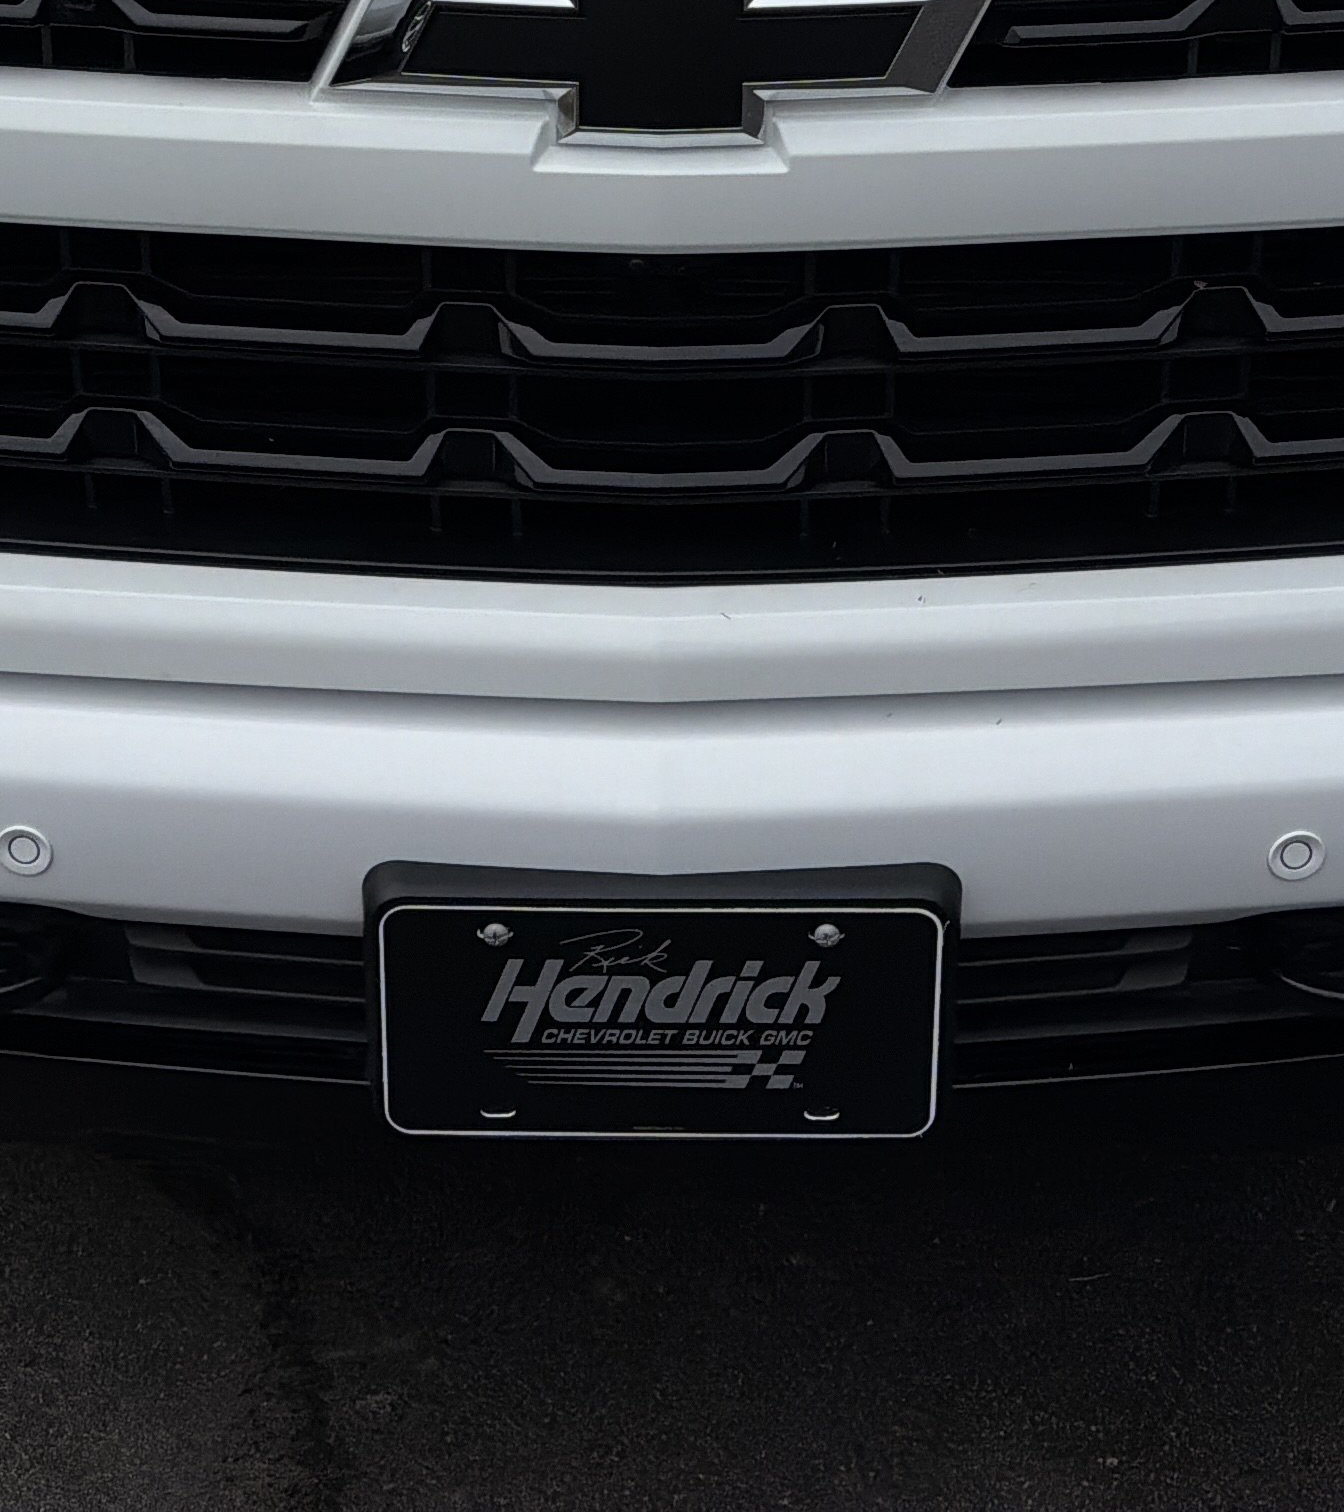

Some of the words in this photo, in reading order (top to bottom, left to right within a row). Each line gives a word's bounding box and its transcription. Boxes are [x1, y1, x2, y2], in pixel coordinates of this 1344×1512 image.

[559, 929, 672, 974] Rick
[481, 958, 842, 1044] Hendrick
[541, 1028, 679, 1045] CHEVROLET
[682, 1029, 755, 1046] BUICK
[759, 1030, 814, 1046] GMC
